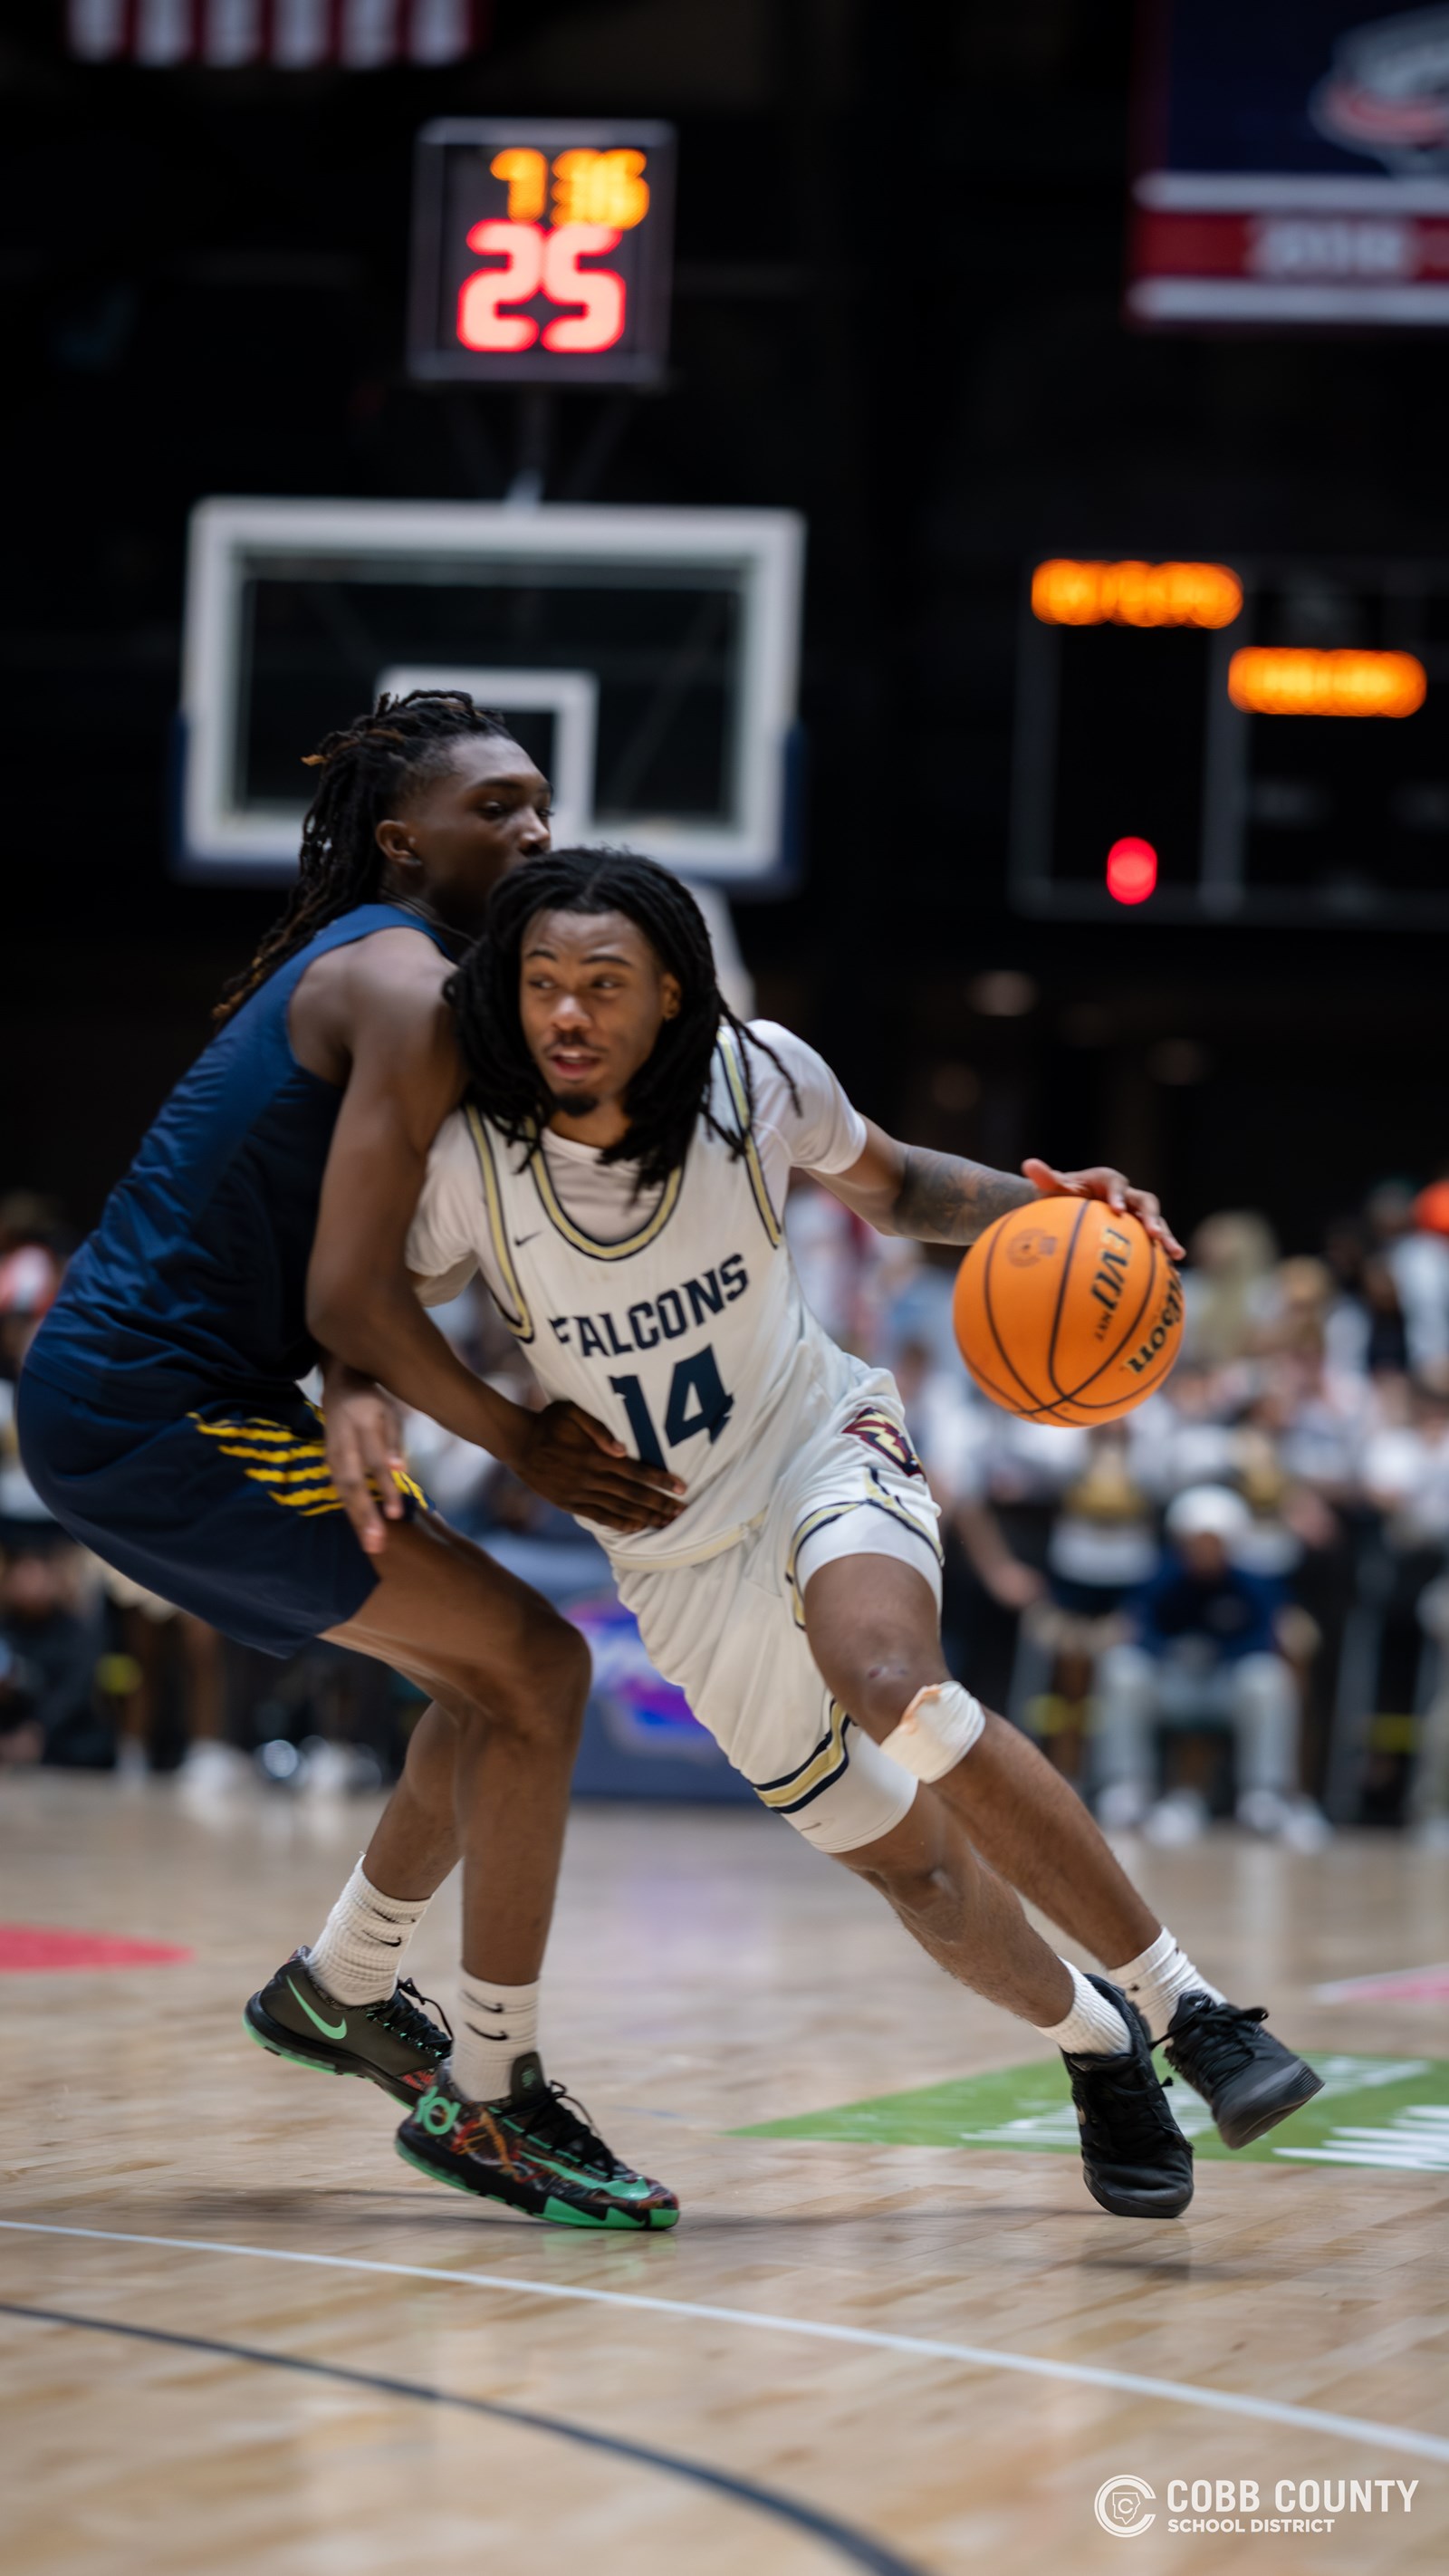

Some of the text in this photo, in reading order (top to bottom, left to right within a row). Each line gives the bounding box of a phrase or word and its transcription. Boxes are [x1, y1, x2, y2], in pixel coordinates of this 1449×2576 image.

[456, 218, 627, 353] 25
[548, 1253, 748, 1357] FALCONS
[609, 1342, 734, 1473] 14
